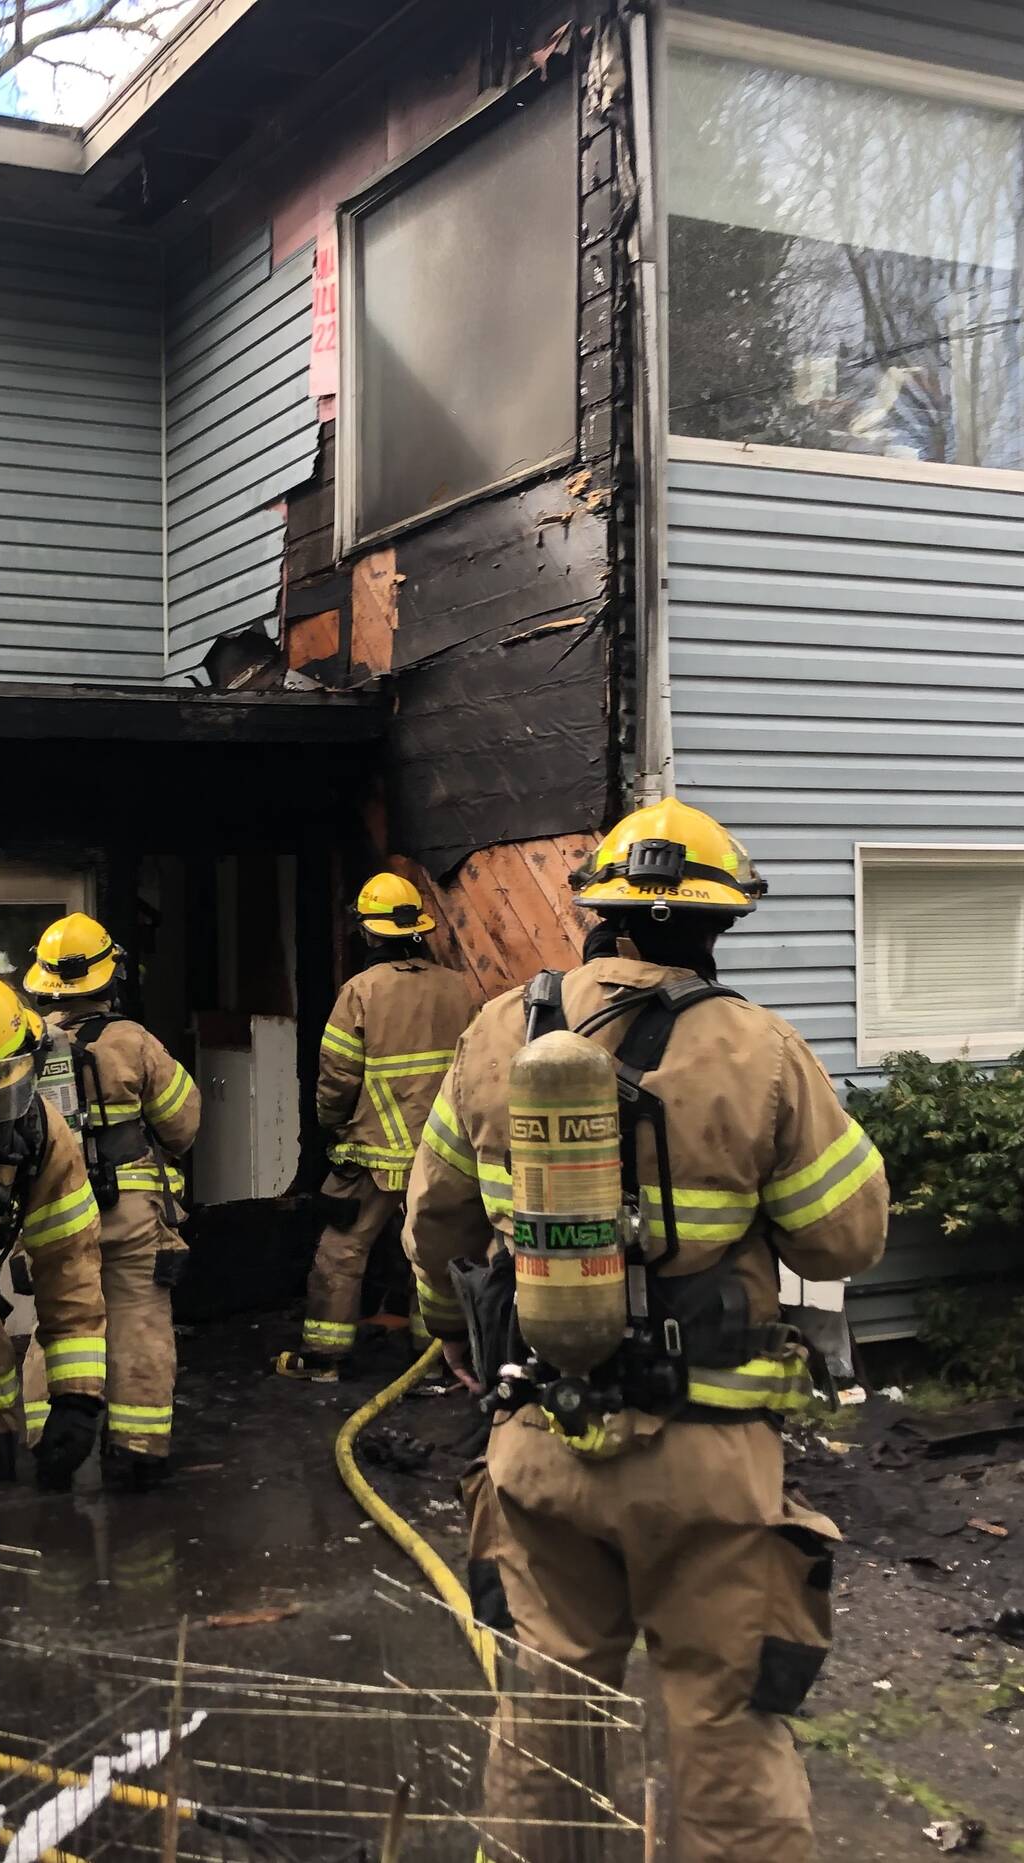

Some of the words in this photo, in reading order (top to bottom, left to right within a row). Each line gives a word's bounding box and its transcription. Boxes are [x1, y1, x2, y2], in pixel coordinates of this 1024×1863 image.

[638, 885, 711, 900] HUSOM
[510, 1118, 546, 1139] SA
[564, 1116, 617, 1139] MSA
[550, 1222, 616, 1247] MSA
